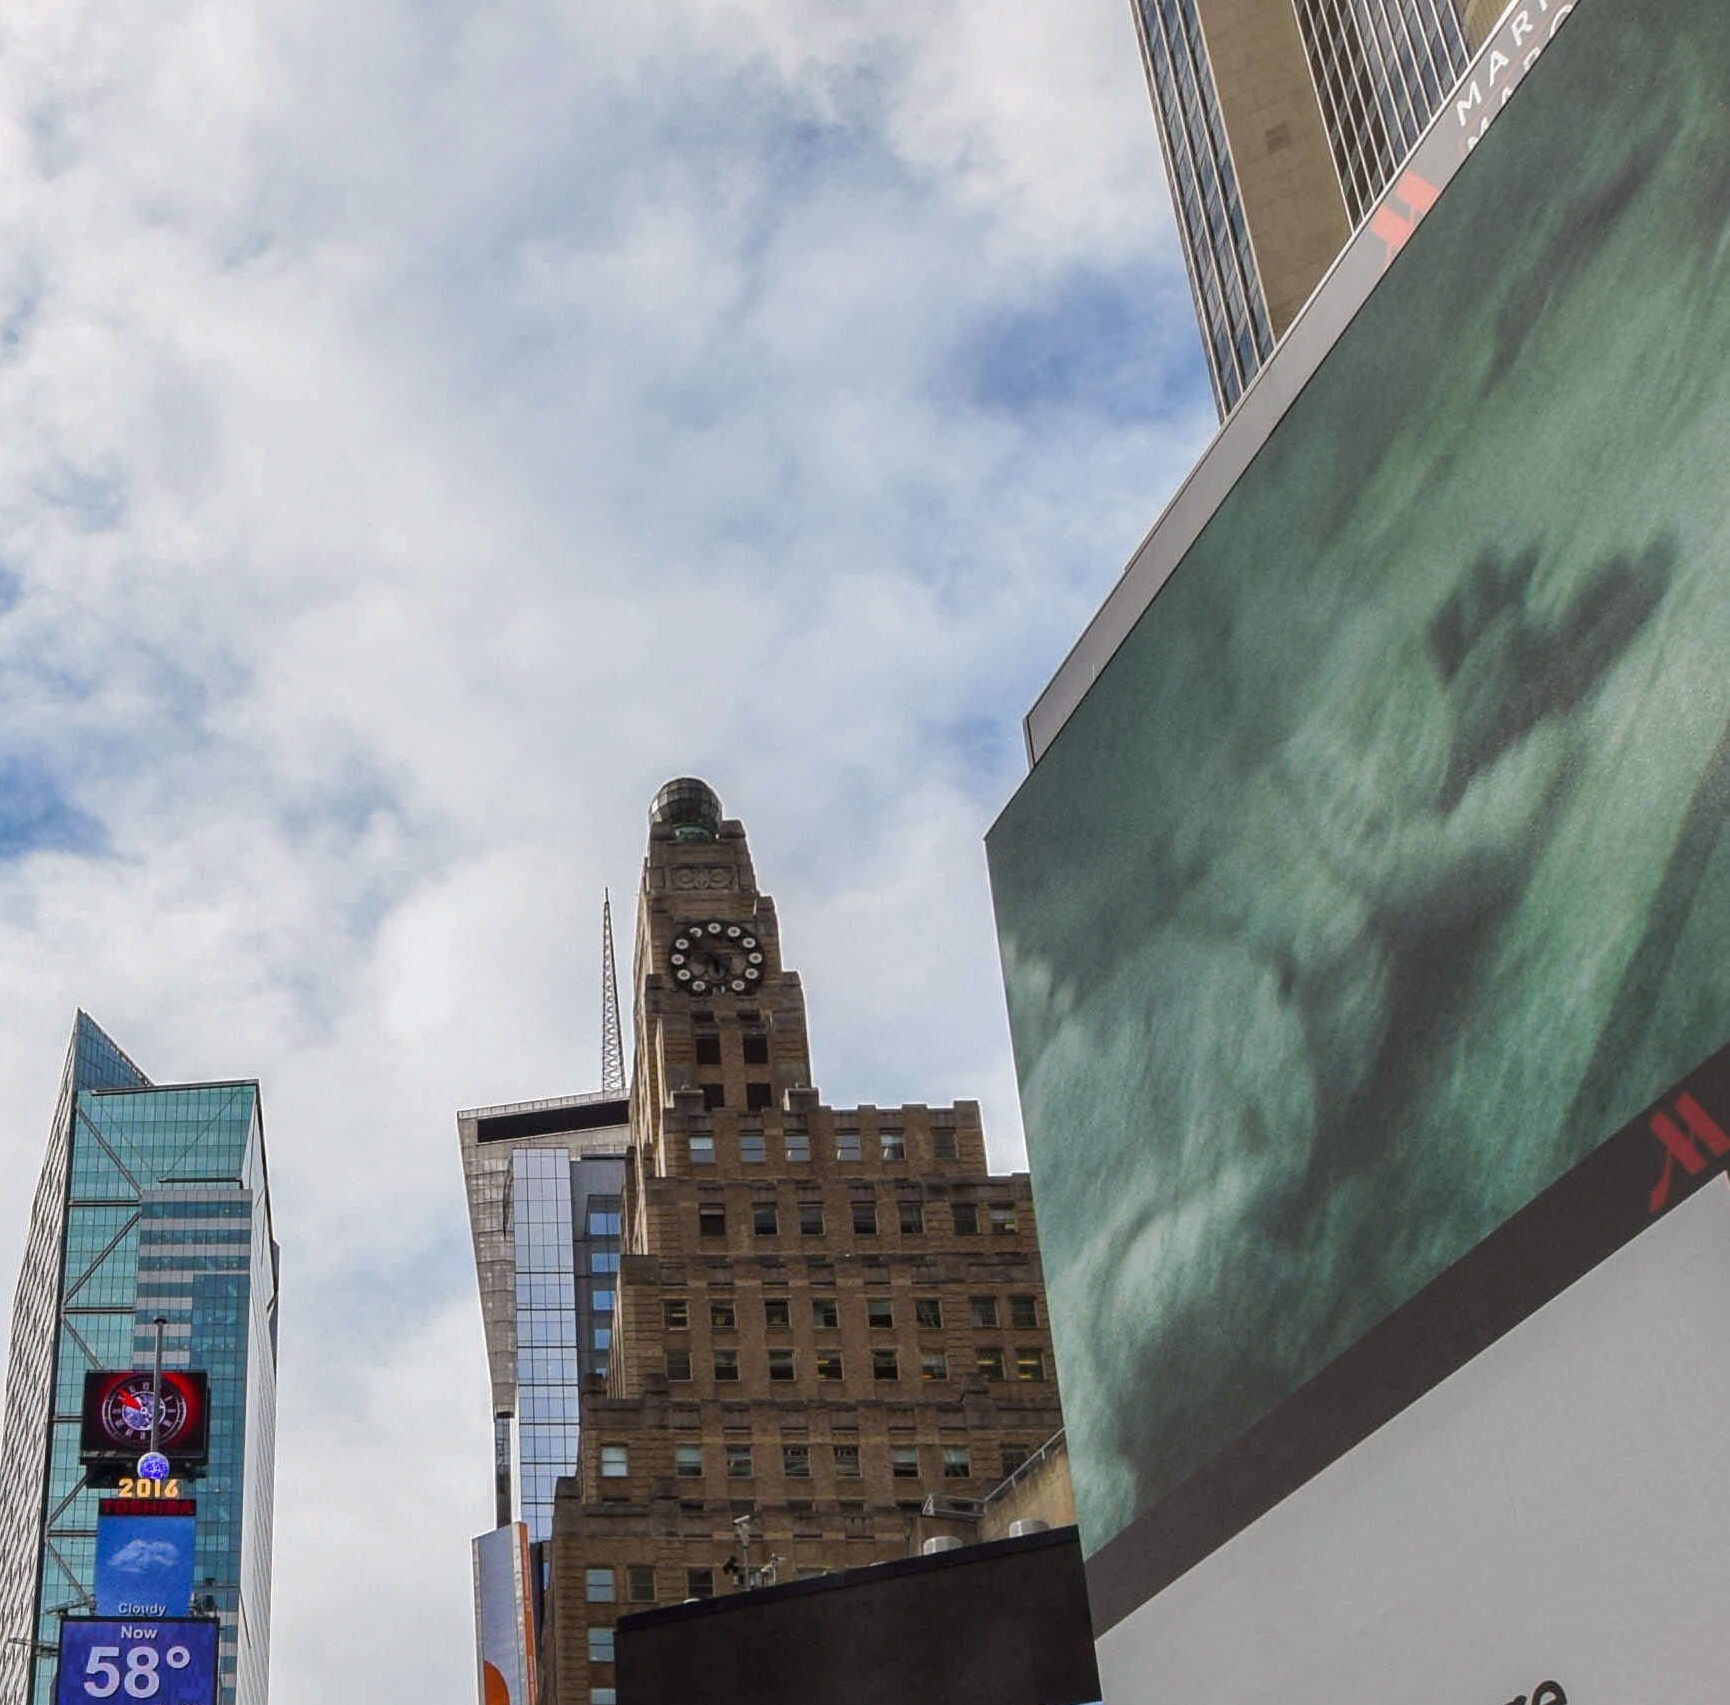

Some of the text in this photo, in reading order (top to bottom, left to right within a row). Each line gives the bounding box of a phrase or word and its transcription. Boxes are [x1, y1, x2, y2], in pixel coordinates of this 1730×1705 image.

[117, 1477, 181, 1499] 2016
[118, 1602, 168, 1617] Cloudy
[120, 1626, 159, 1640] Now
